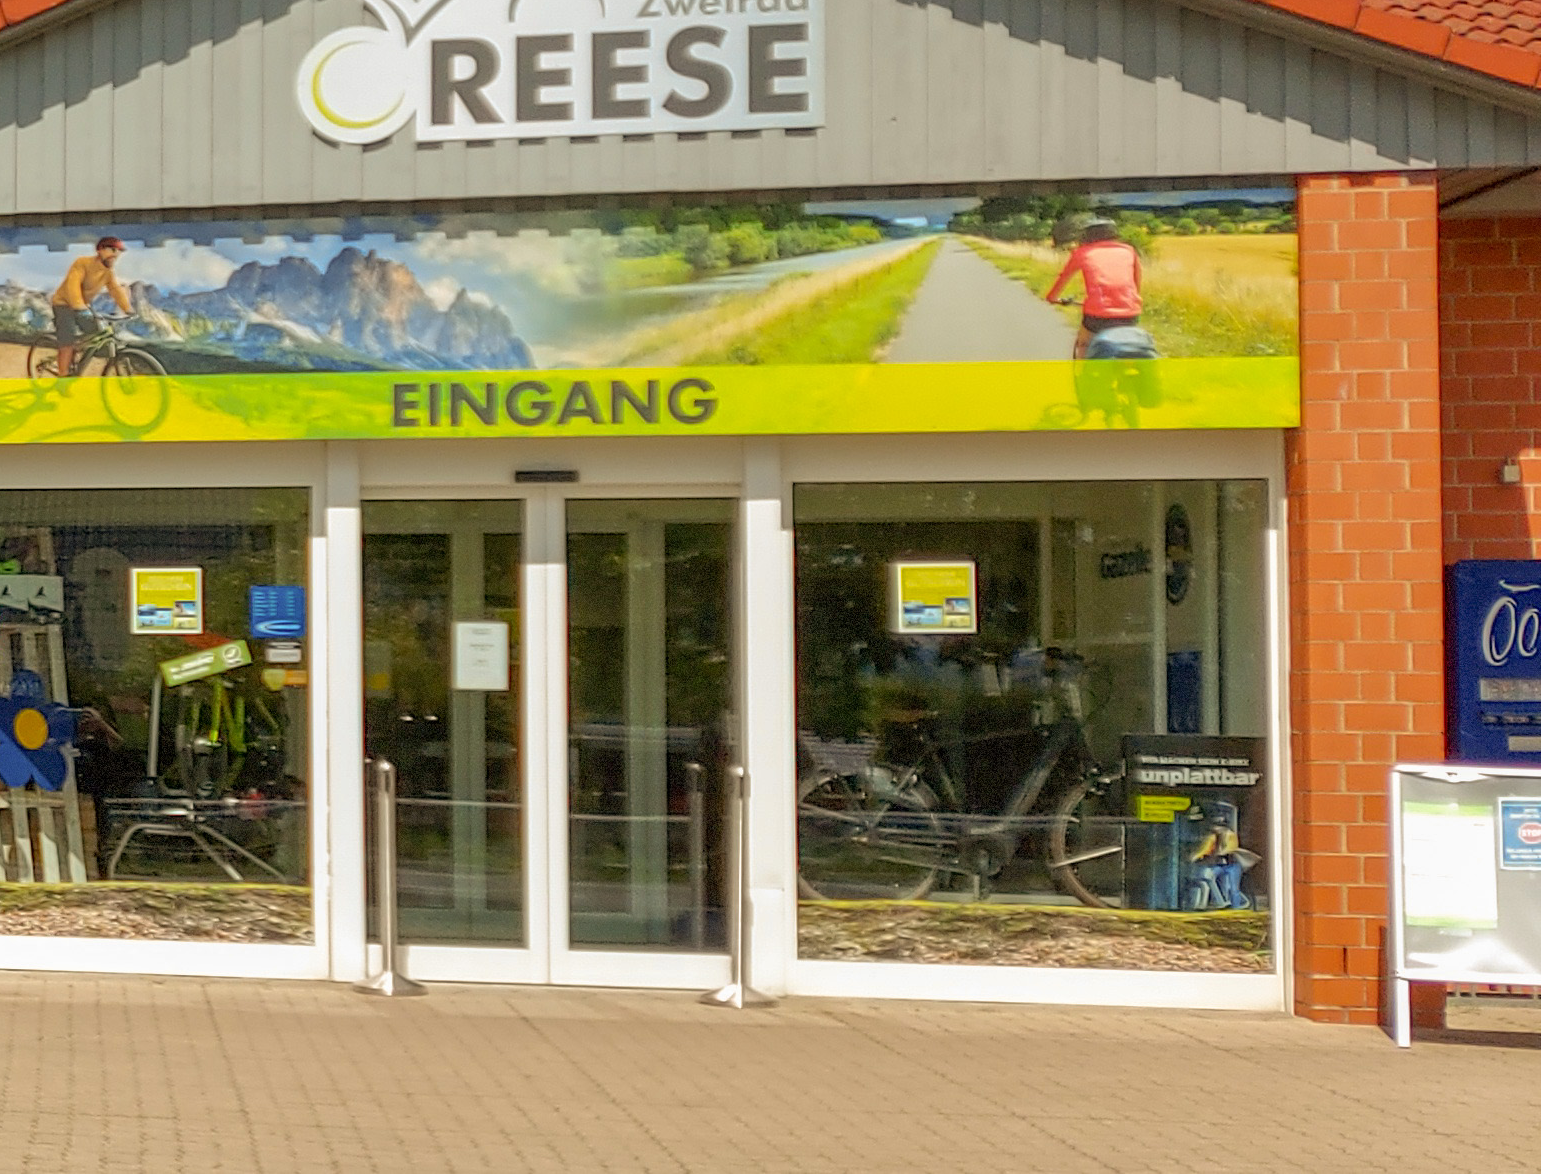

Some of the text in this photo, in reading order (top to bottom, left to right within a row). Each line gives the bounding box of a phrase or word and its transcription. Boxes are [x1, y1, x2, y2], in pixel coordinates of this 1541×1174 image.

[431, 23, 810, 125] REESE
[393, 378, 718, 426] EINGANG
[1138, 767, 1261, 787] unplattbar
